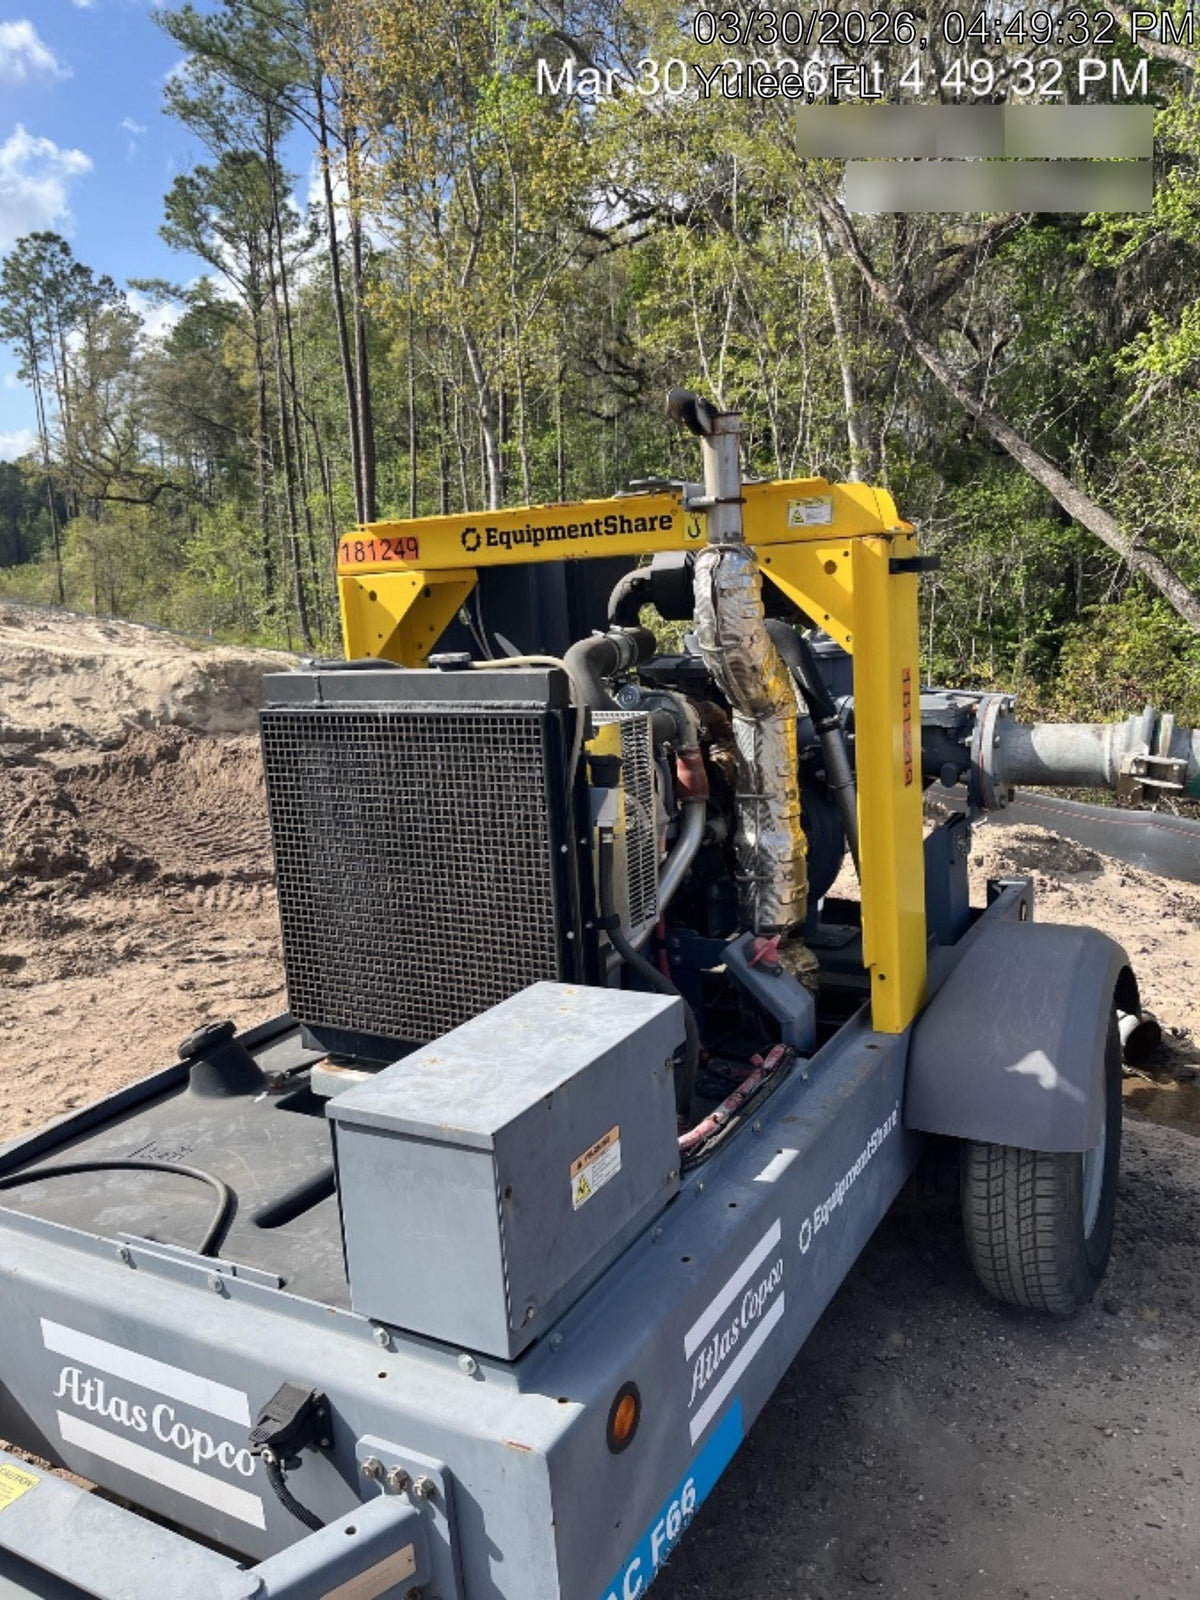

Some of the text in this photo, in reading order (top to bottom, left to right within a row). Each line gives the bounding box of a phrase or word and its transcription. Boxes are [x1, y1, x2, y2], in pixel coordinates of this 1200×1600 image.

[342, 537, 419, 562] 181249
[485, 514, 674, 549] EquipmentShare
[814, 1108, 898, 1235] EquipmentShare
[687, 1258, 783, 1408] Atlas Copco
[53, 1366, 256, 1477] Atlas Copco
[650, 1477, 696, 1570] F66
